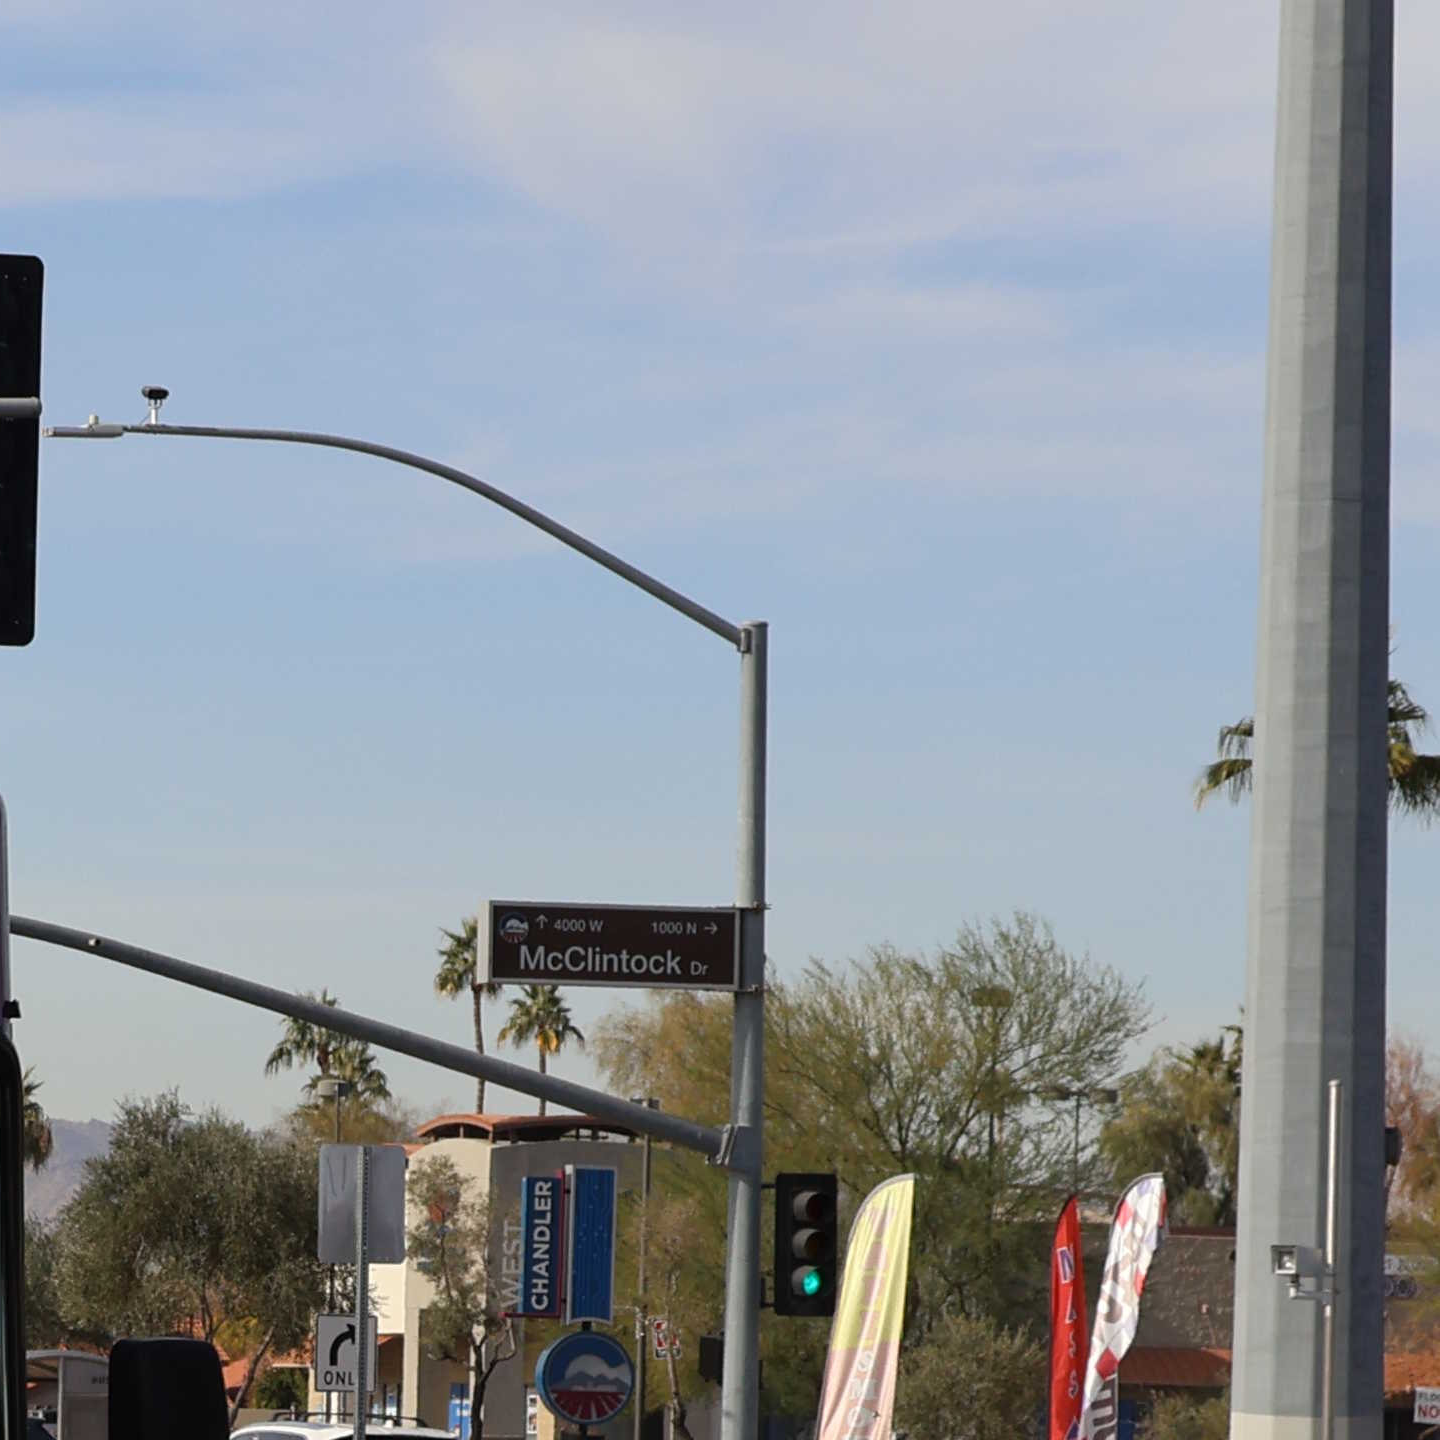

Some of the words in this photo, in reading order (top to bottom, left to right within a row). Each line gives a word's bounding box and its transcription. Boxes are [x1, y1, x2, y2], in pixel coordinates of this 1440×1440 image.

[553, 919, 586, 932] 4000
[586, 920, 604, 932] W
[686, 922, 698, 935] N
[520, 945, 682, 976] McClintock
[690, 961, 709, 976] Dr
[531, 1181, 552, 1311] CHANDLER
[501, 1219, 525, 1308] WEST
[324, 1370, 355, 1386] ONL
